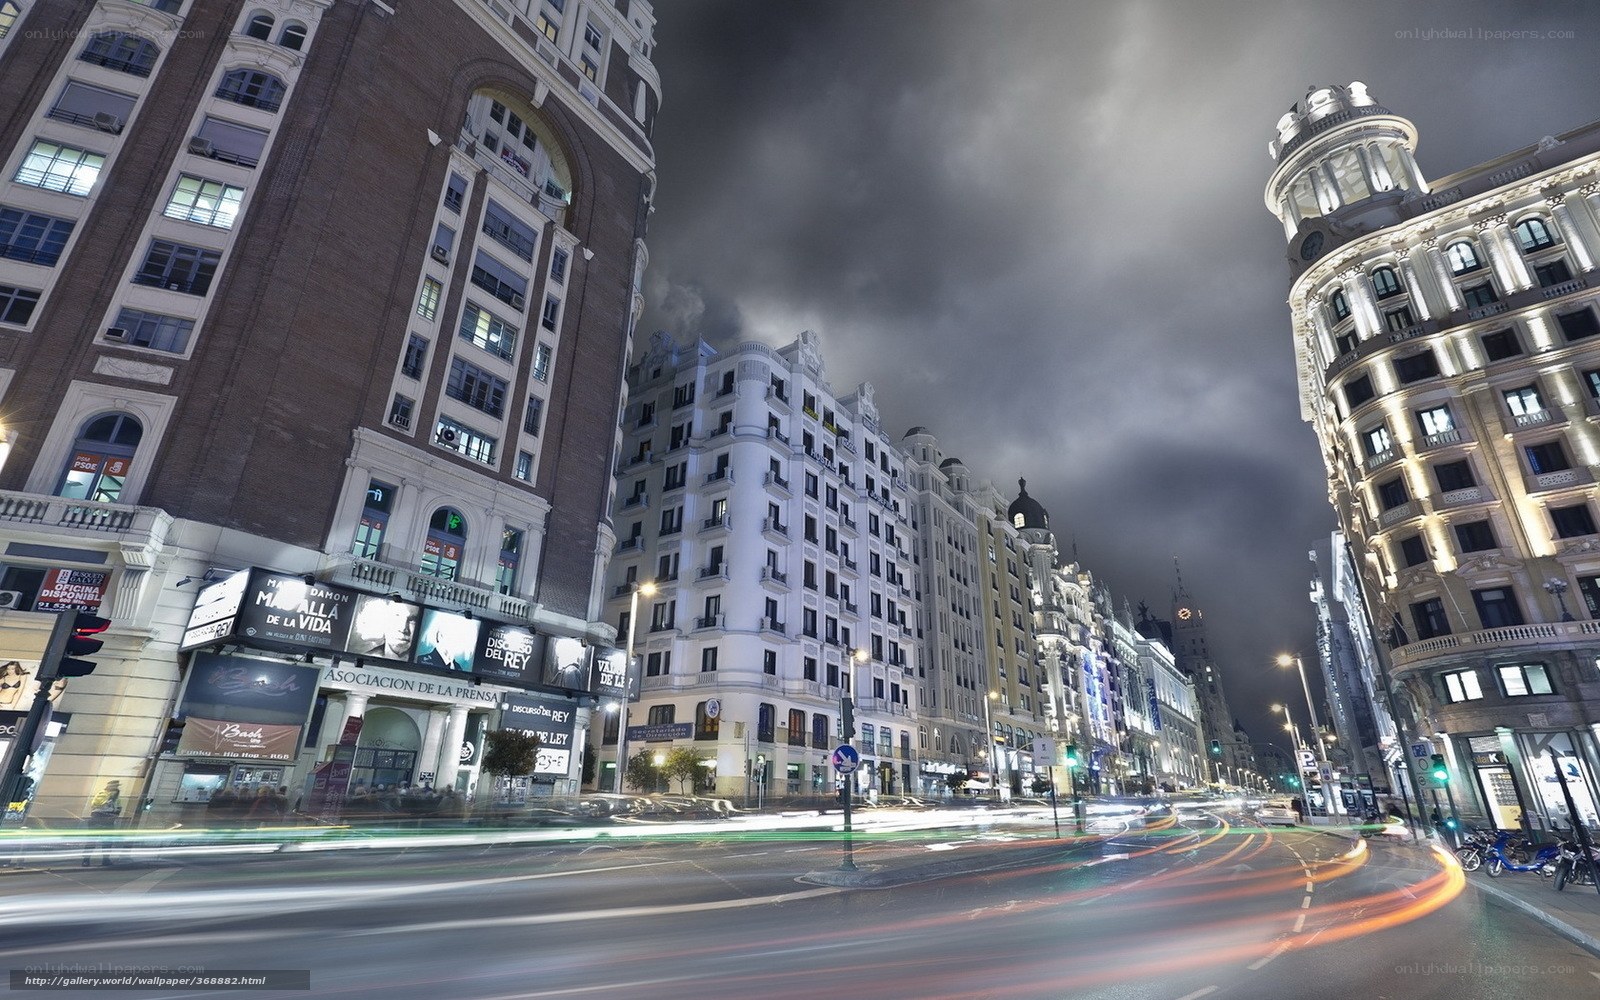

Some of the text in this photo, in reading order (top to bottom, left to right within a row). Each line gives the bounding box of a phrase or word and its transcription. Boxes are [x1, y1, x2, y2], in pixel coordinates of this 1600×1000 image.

[74, 462, 98, 471] PSOE
[41, 589, 104, 601] DISPONIBL
[55, 584, 99, 594] OFICINA
[310, 588, 349, 603] DAMON
[266, 614, 332, 634] DE LA VIDA
[485, 648, 531, 670] DEL REY
[324, 669, 499, 703] ASOCIACION DE LA PRENSA
[600, 672, 612, 686] DE
[512, 705, 541, 715] DISCURSO
[542, 708, 551, 717] DEL
[552, 711, 569, 723] REY
[221, 723, 263, 739] Bash
[549, 732, 568, 745] LEY
[223, 751, 239, 759] Hip
